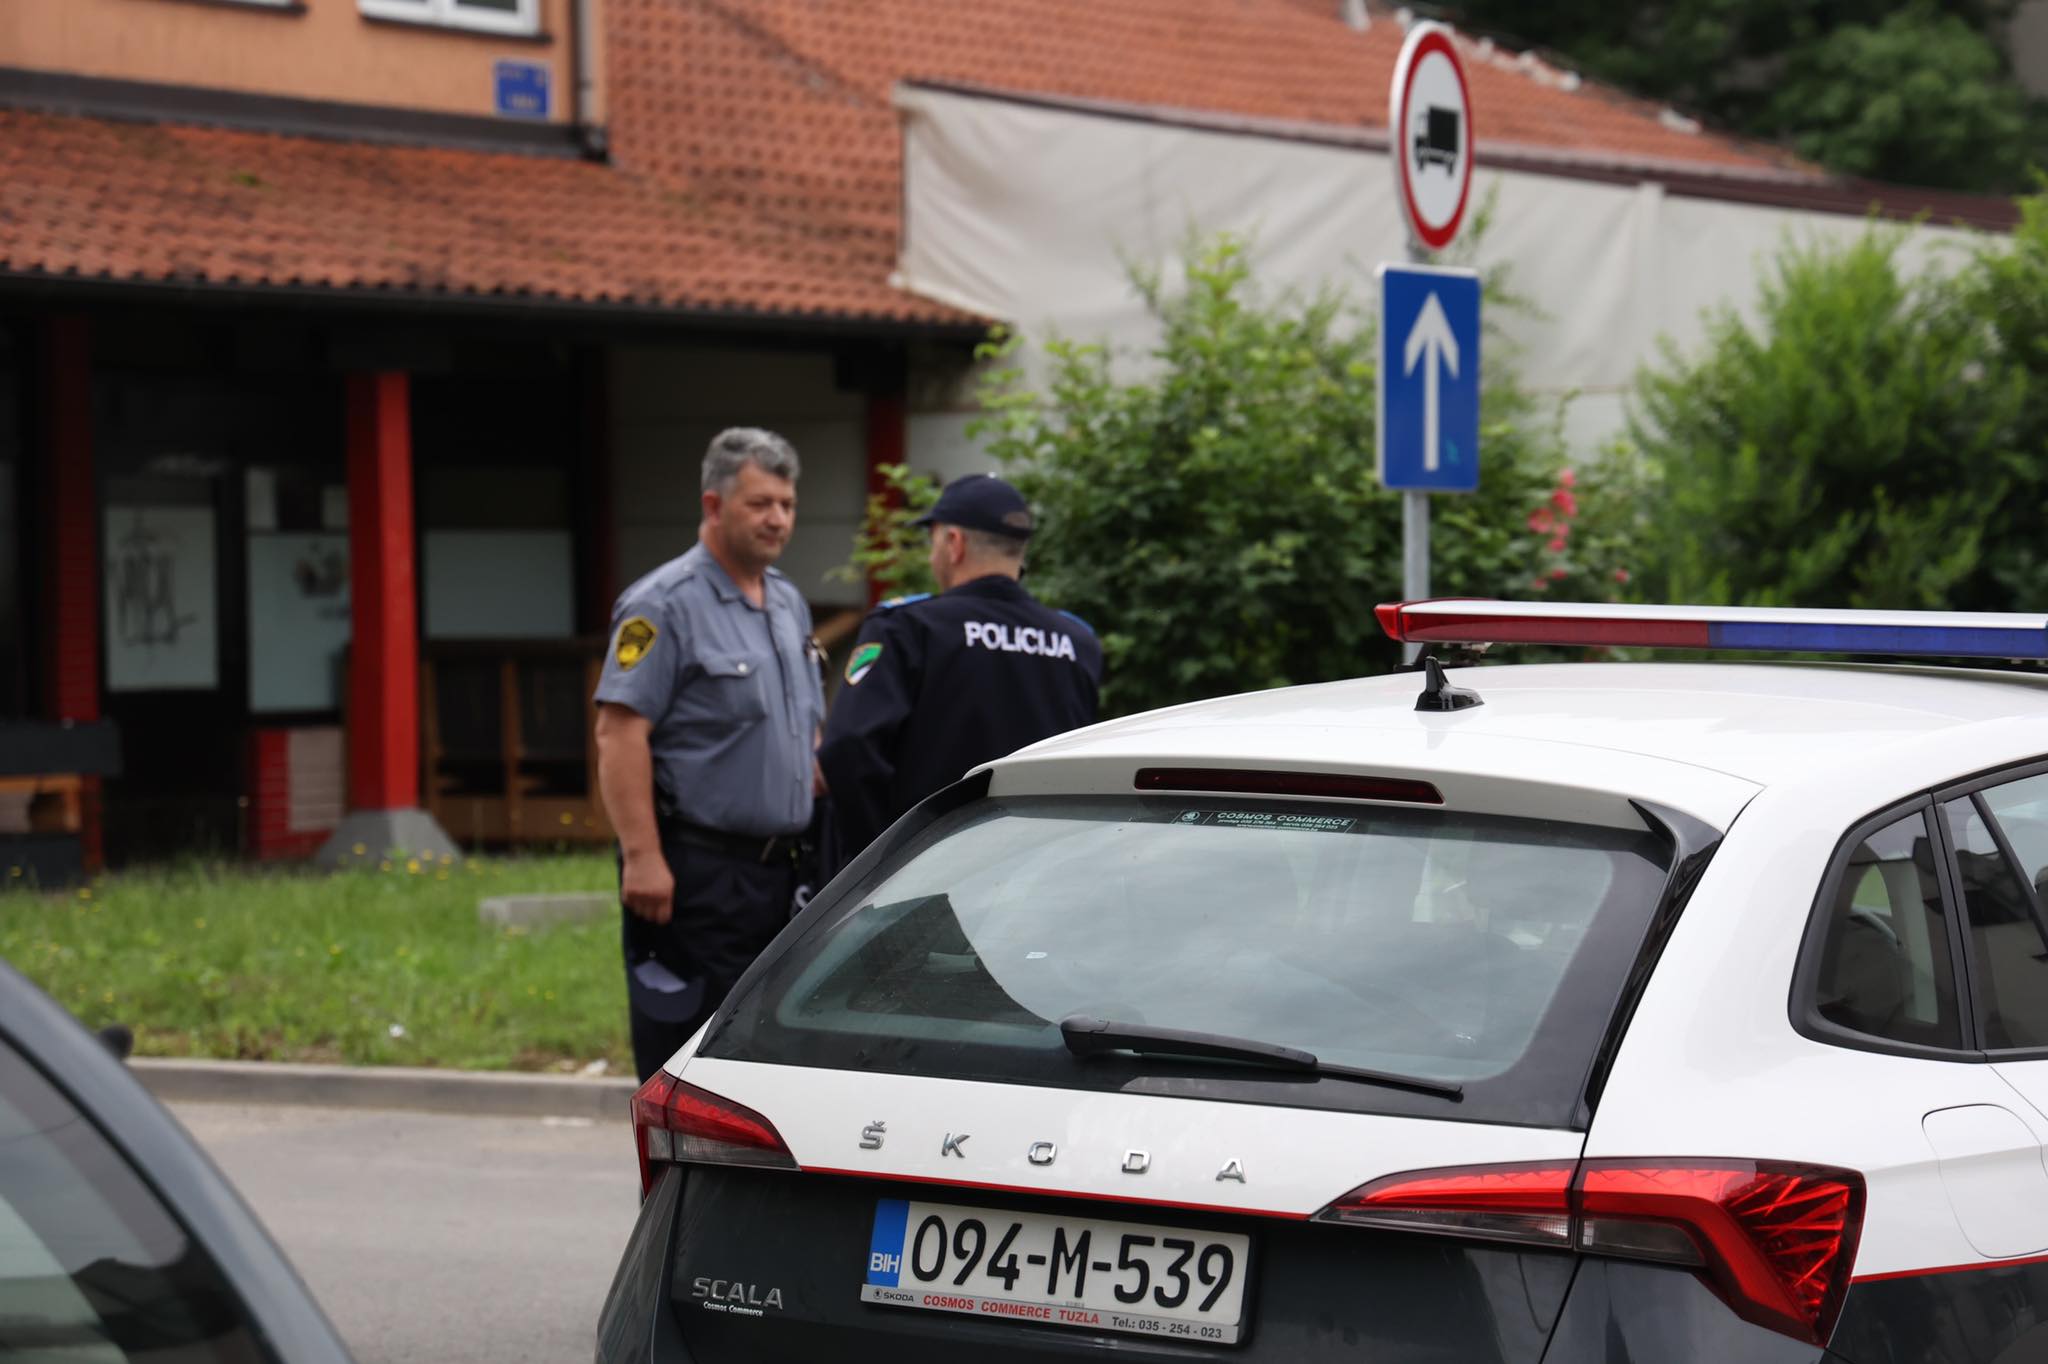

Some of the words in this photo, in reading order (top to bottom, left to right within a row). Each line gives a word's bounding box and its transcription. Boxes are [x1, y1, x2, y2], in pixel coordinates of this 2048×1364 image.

[964, 621, 1077, 661] POLICIJA
[1217, 812, 1273, 821] COSMOS
[1277, 815, 1351, 826] COMMERCE
[859, 1120, 1247, 1184] ŠKODA
[870, 1252, 900, 1274] BIH
[911, 1214, 1235, 1313] 094-M-539
[692, 1277, 783, 1310] SCALA
[883, 1291, 915, 1303] ŠKODA
[703, 1301, 727, 1312] Cosmos
[728, 1305, 764, 1317] Commerce
[923, 1295, 975, 1311] COSMOS
[981, 1301, 1052, 1319] COMMERCE
[1059, 1310, 1100, 1325] TUZLA
[1112, 1316, 1136, 1329] Tel.:
[1138, 1319, 1160, 1332] 035
[1169, 1322, 1191, 1335] 254
[1200, 1327, 1223, 1339] 023
